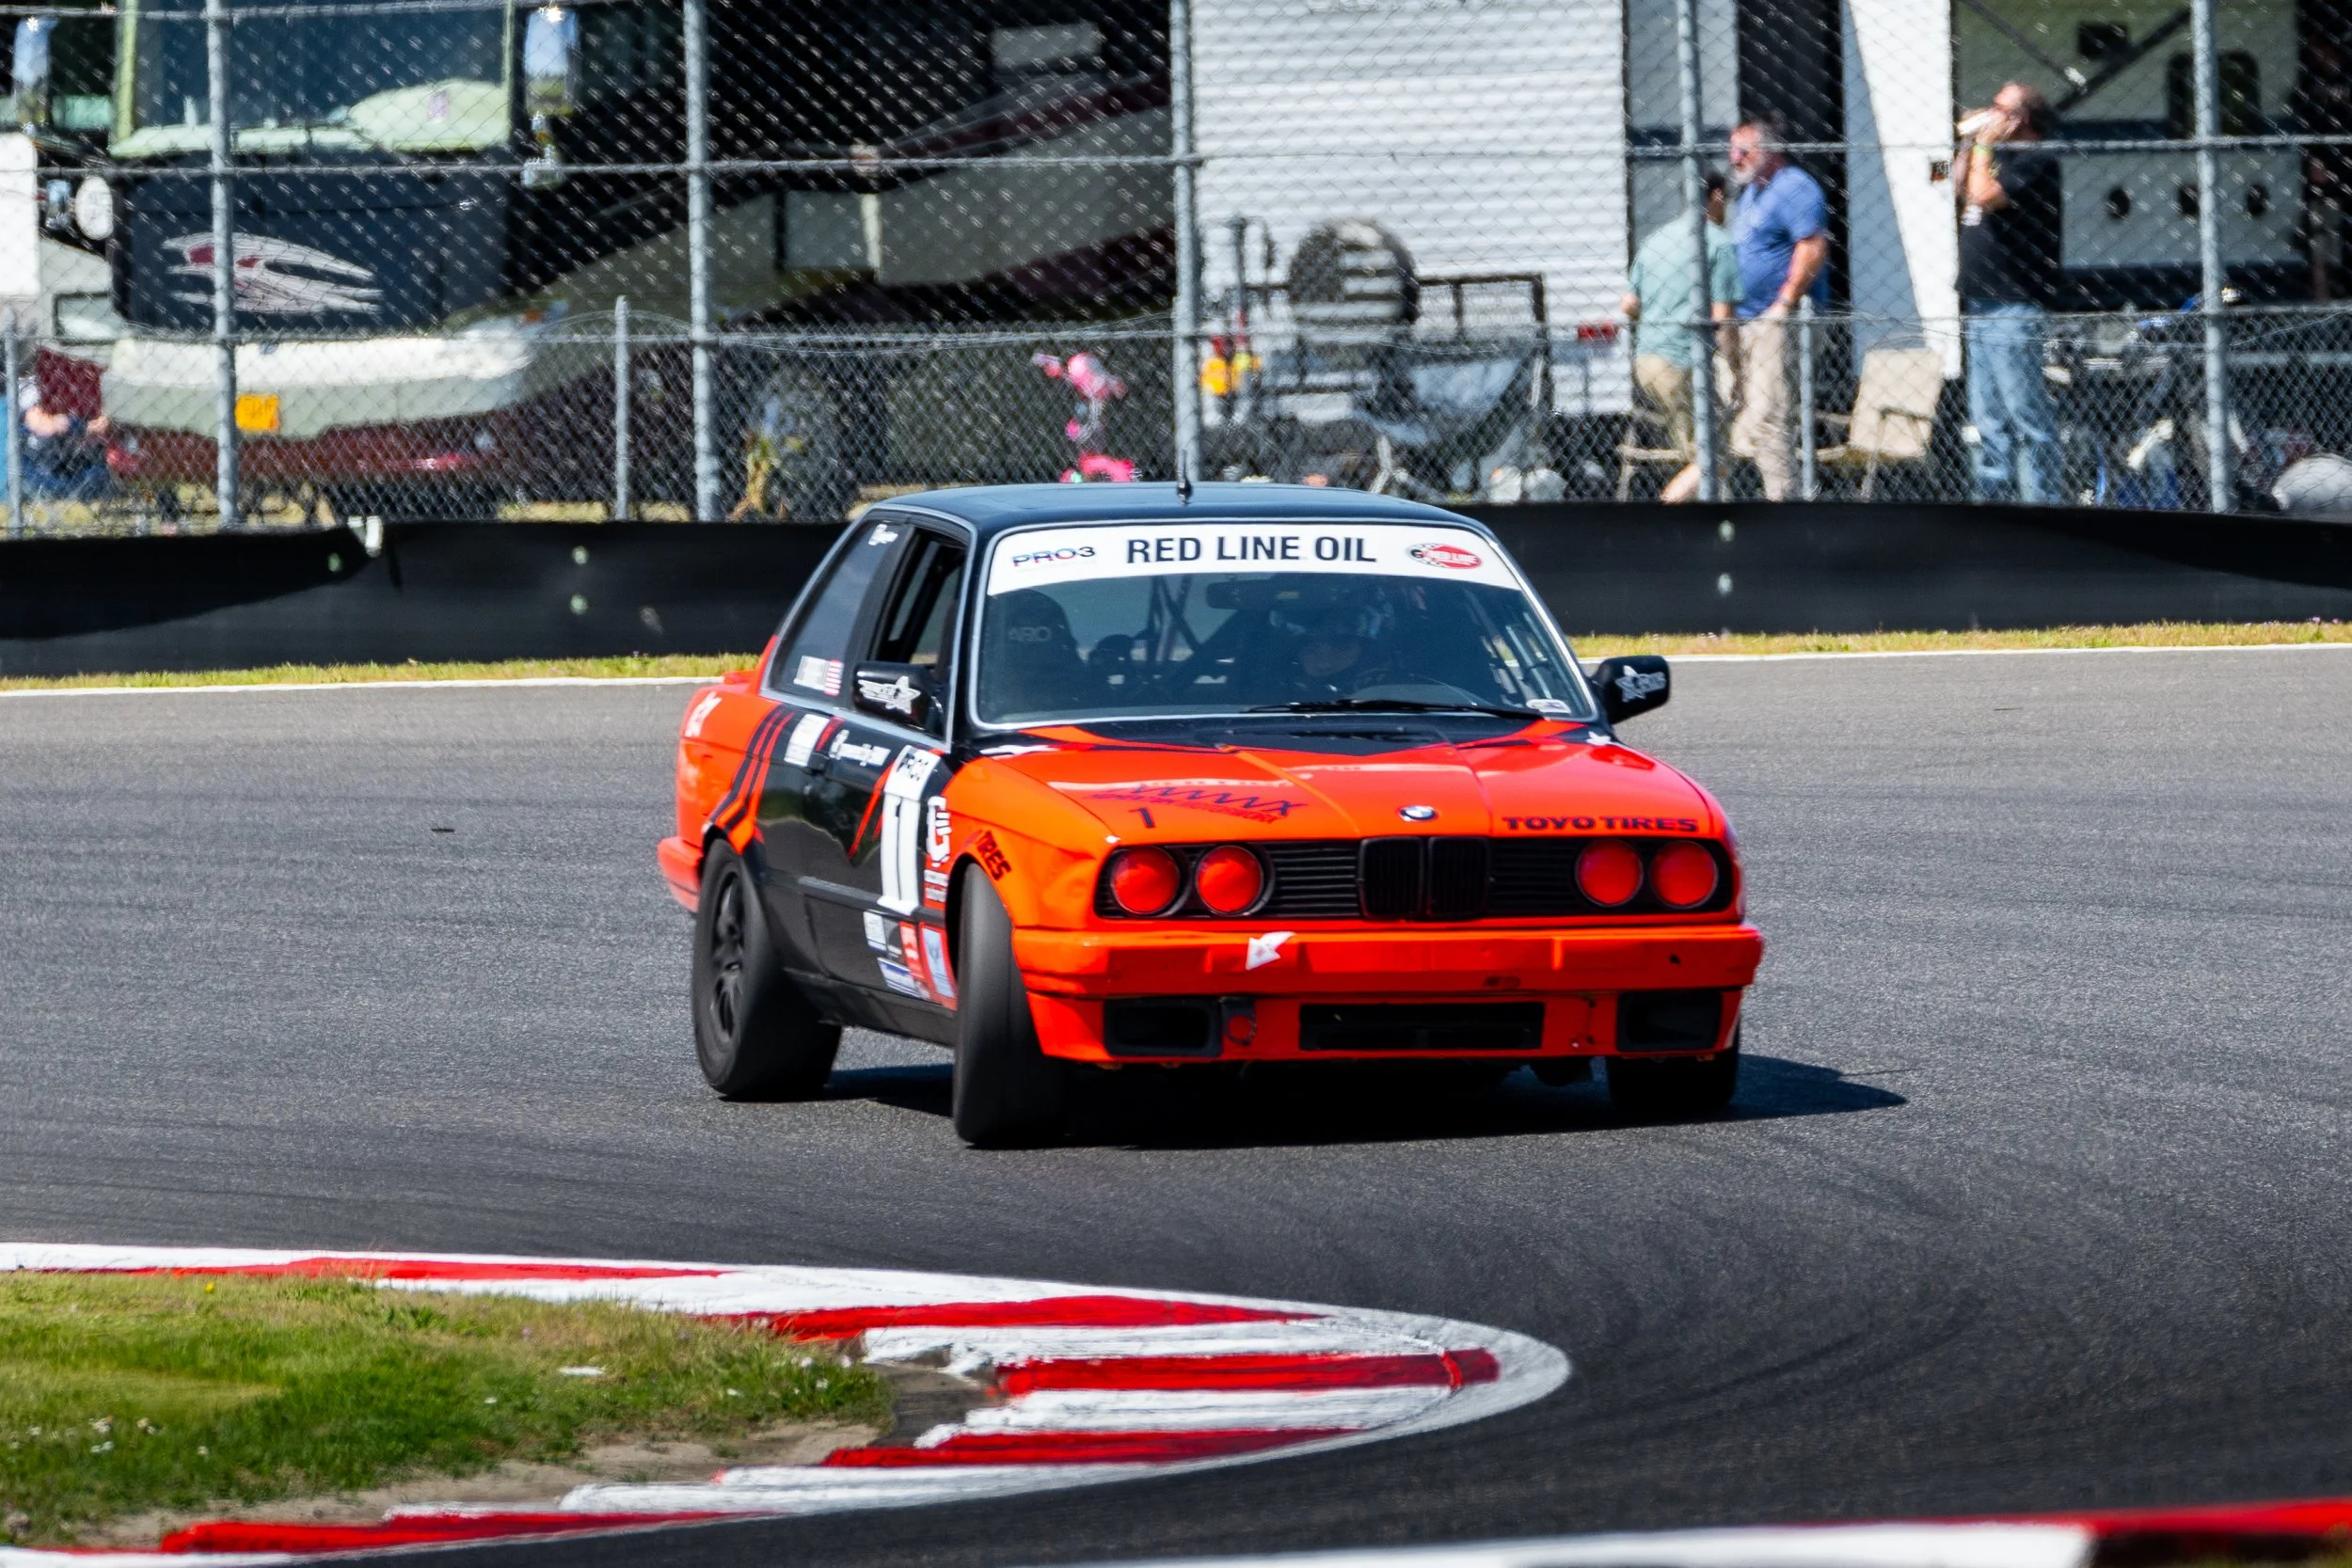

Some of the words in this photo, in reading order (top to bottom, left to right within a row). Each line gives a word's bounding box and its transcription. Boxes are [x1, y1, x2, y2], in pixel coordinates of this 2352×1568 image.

[1012, 546, 1096, 568] PRO3
[1126, 537, 1201, 564] RED
[1216, 535, 1300, 561] LINE
[1314, 535, 1377, 562] OIL
[1502, 816, 1595, 831] TOYO
[1599, 816, 1699, 832] TIRES
